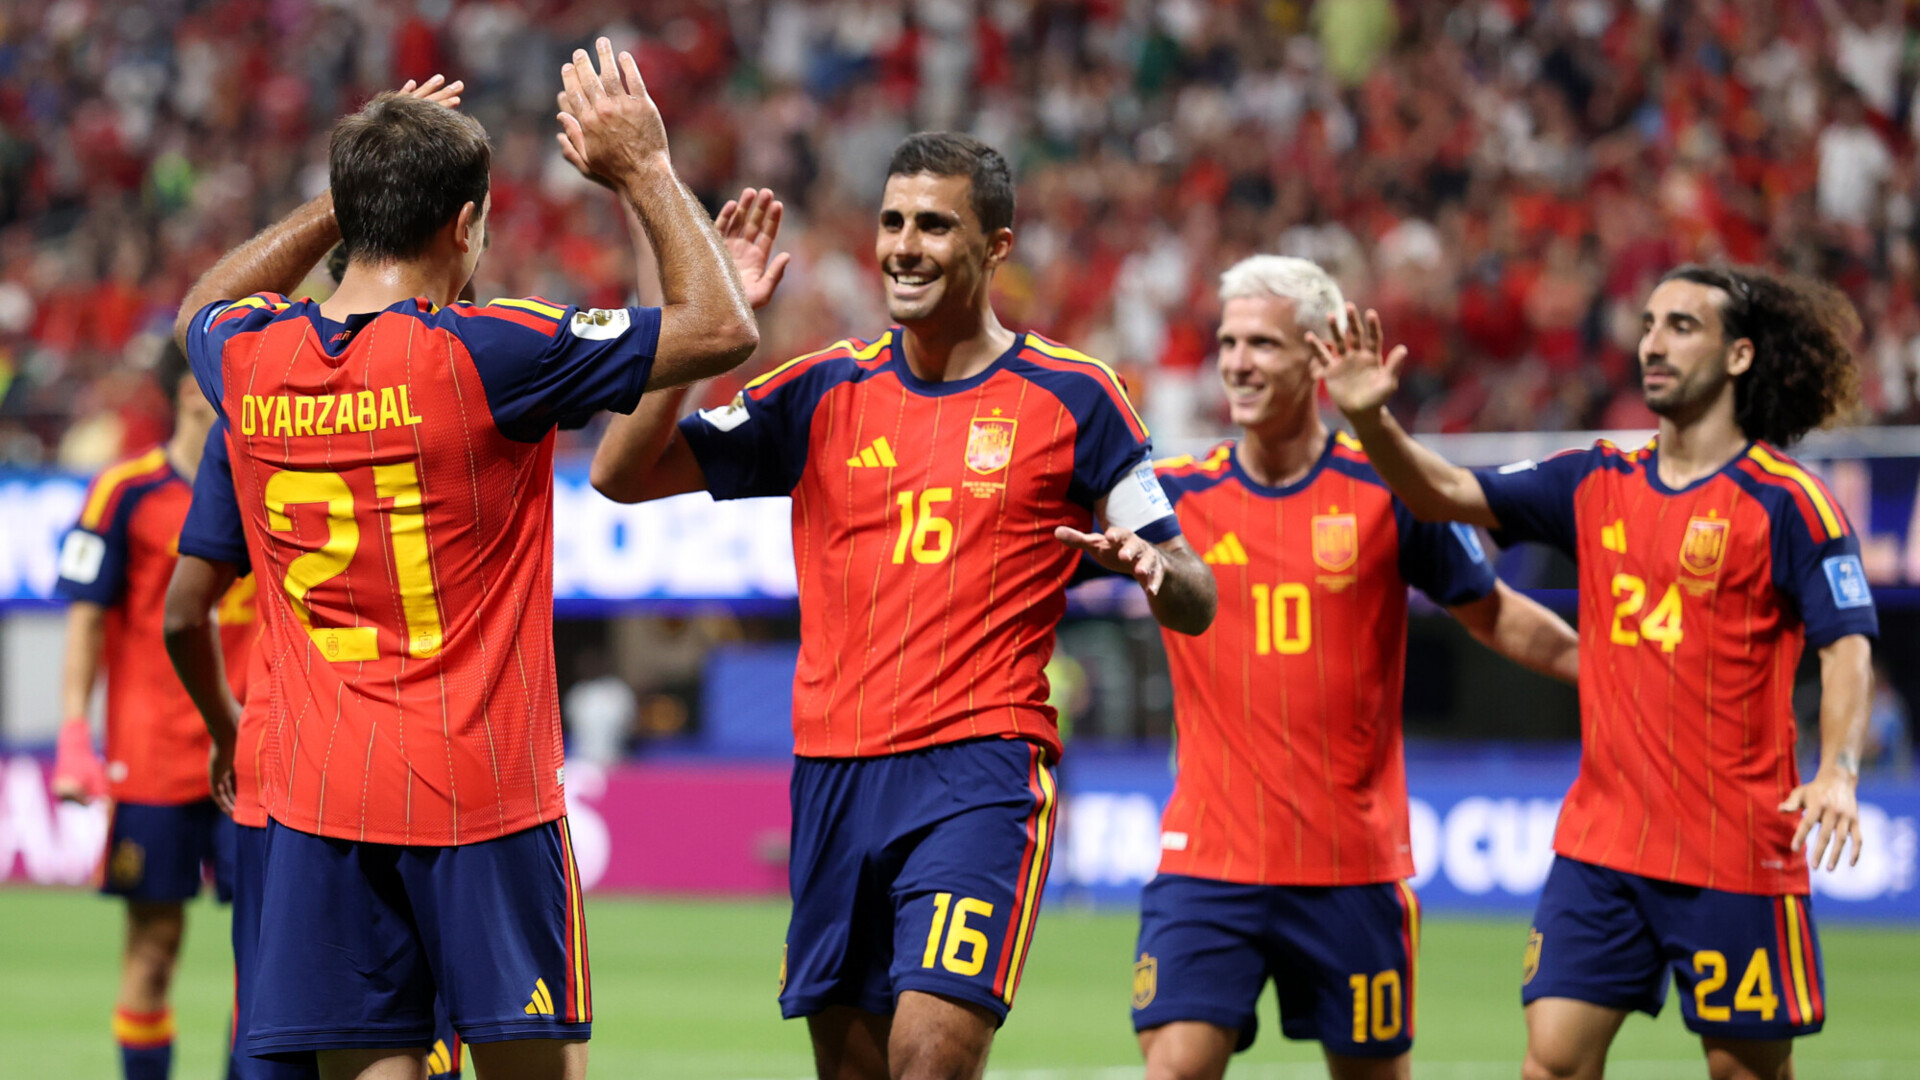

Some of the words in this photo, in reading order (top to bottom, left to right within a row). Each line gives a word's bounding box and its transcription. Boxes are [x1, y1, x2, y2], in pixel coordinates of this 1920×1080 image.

[241, 384, 423, 437] OYARZABAL
[264, 462, 444, 662] 21
[892, 487, 954, 564] 16
[1252, 582, 1312, 656] 10
[1610, 573, 1684, 653] 24
[921, 892, 994, 977] 16
[1349, 970, 1402, 1042] 10
[1692, 948, 1779, 1022] 24
